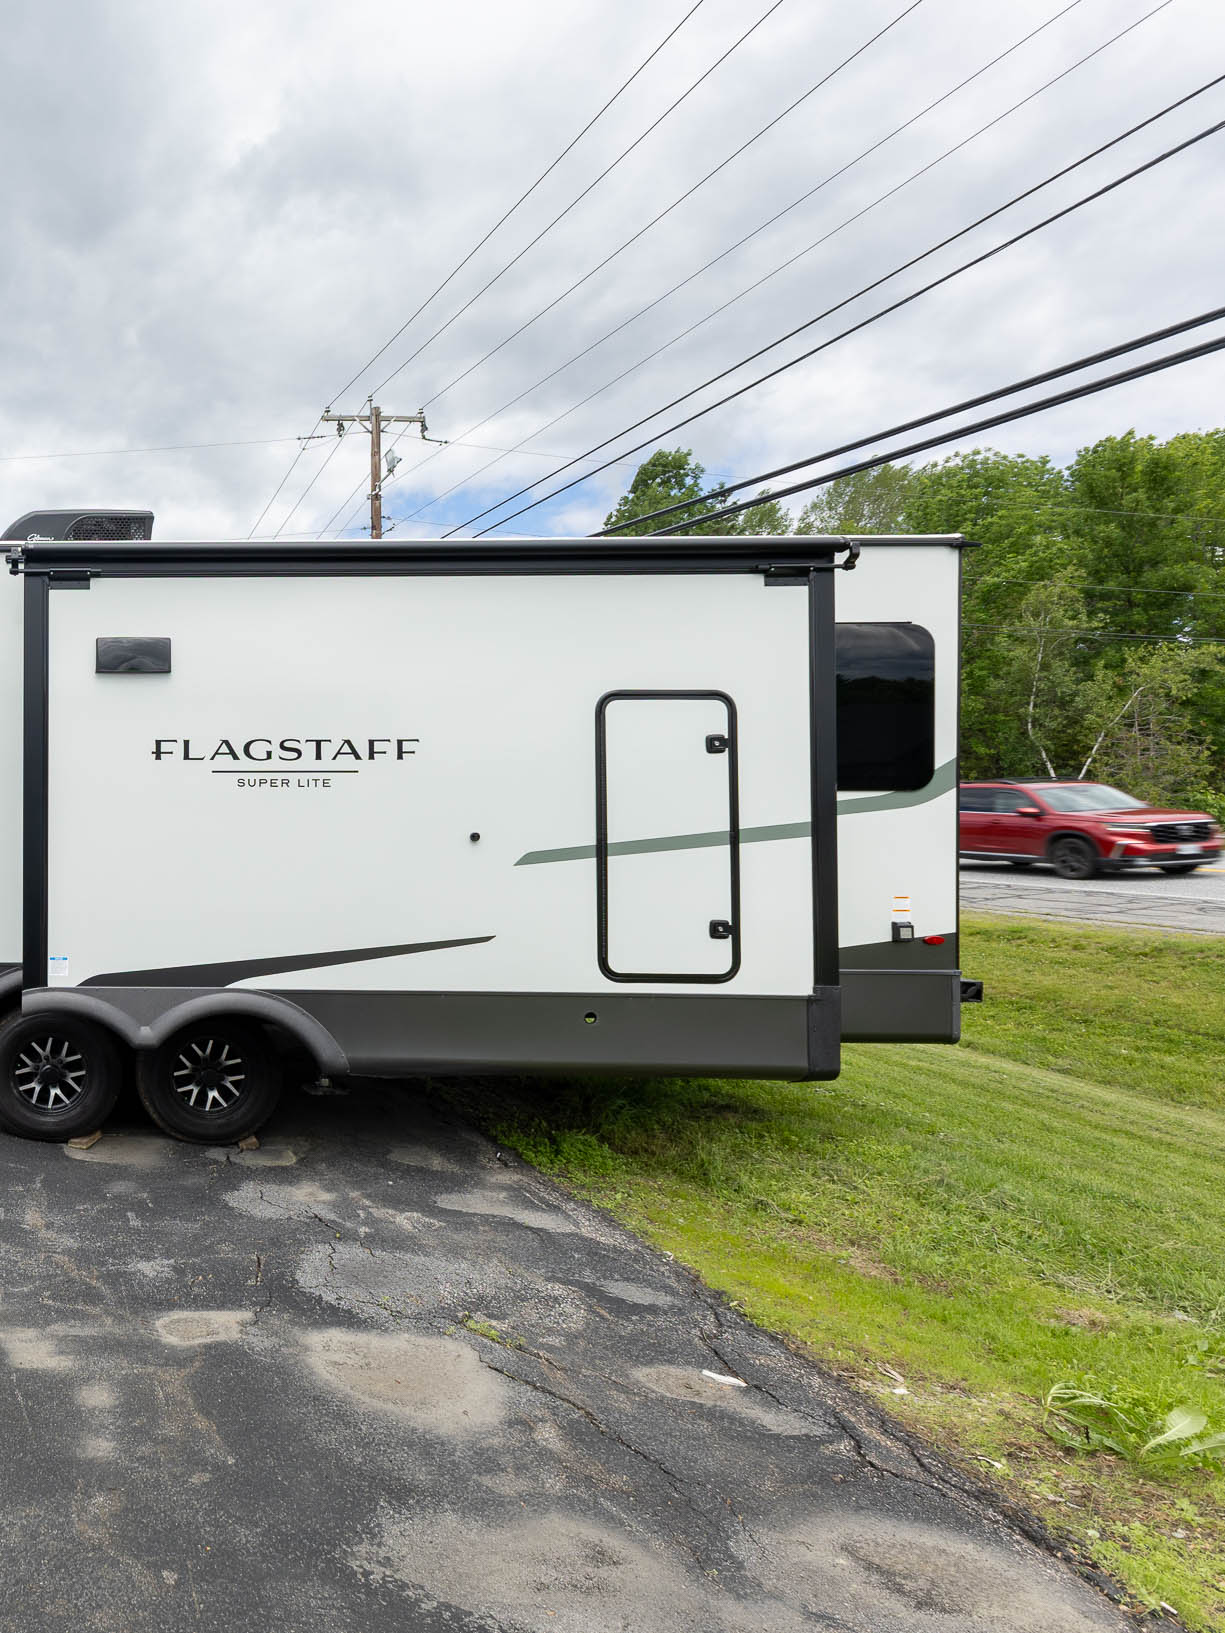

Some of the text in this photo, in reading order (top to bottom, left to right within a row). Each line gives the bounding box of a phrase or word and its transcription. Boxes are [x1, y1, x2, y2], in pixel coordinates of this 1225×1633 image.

[151, 738, 420, 761] FLAGSTAFF
[237, 778, 331, 787] SUPER LITE
